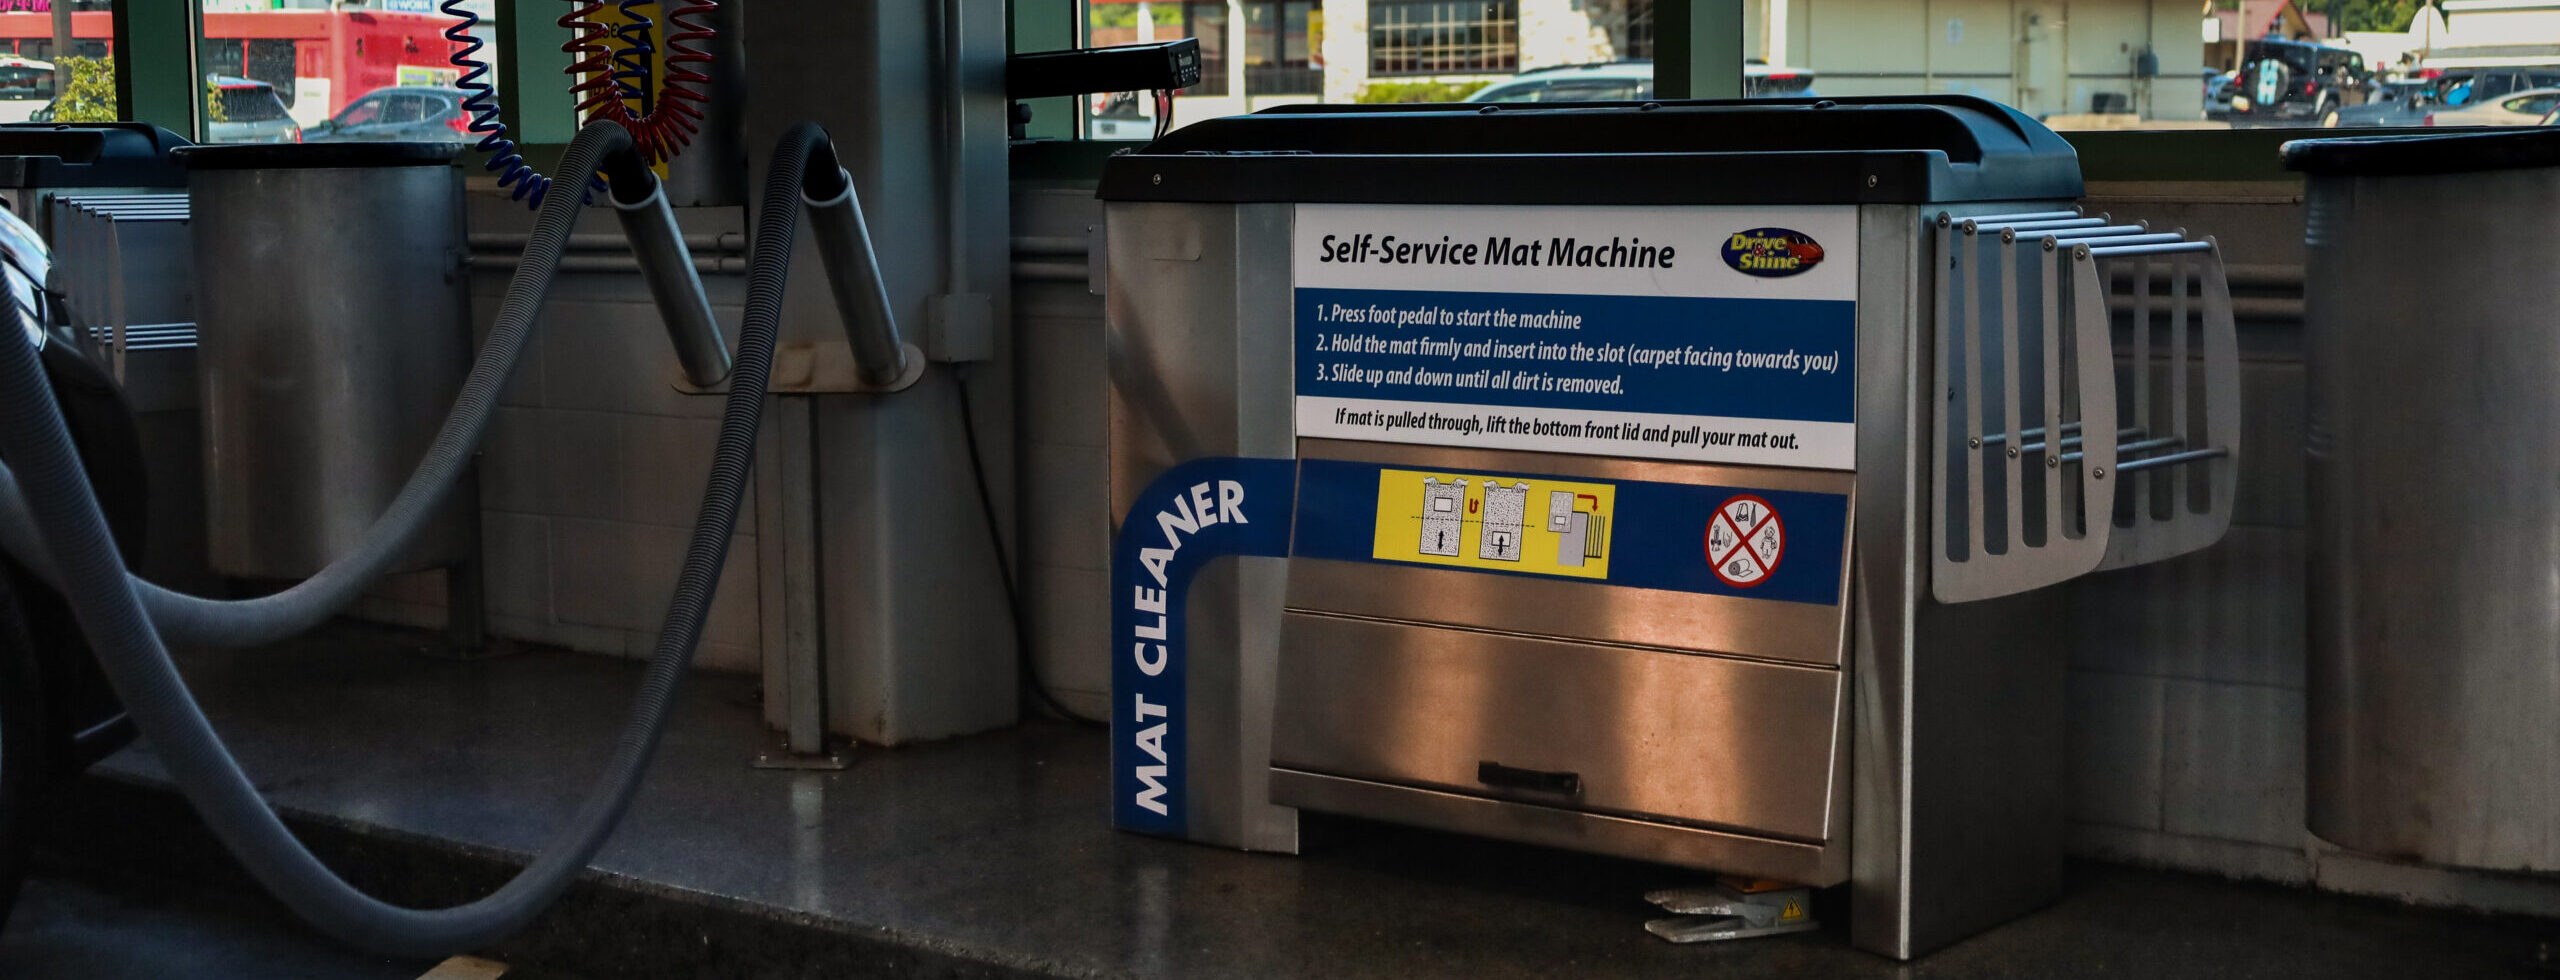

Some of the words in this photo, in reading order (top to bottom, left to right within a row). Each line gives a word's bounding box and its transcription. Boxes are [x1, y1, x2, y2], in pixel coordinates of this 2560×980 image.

[1320, 233, 1478, 266] Self-Service
[1483, 236, 1543, 267] Mat
[1547, 236, 1676, 269] Machine
[1731, 231, 1788, 250] Drive
[1739, 250, 1800, 270] Shine
[1317, 303, 1329, 323] 1.
[1331, 303, 1365, 324] Press
[1368, 304, 1398, 325] foot
[1397, 305, 1438, 329] pedal
[1439, 308, 1454, 326] to
[1455, 309, 1492, 327] start
[1493, 307, 1517, 328] the
[1519, 309, 1582, 330] machine
[1315, 333, 1329, 352] 2.
[1331, 333, 1364, 353] Hold
[1364, 334, 1388, 354] the
[1389, 340, 1417, 357] mat
[1420, 337, 1462, 362] firmly
[1463, 338, 1492, 358] and
[1493, 339, 1536, 360] insert
[1537, 340, 1568, 361] into
[1570, 341, 1595, 362] the
[1596, 342, 1626, 363] slot
[1627, 343, 1682, 370] (carpet
[1683, 345, 1733, 372] facing
[1735, 348, 1801, 370] towards
[1802, 350, 1839, 376] you)
[1316, 363, 1329, 381] 3.
[1331, 363, 1364, 383] Slide
[1365, 369, 1384, 389] up
[1385, 366, 1413, 385] and
[1414, 366, 1453, 387] down
[1455, 369, 1490, 389] until
[1491, 370, 1511, 390] all
[1512, 370, 1540, 391] dirt
[1541, 371, 1554, 392] is
[1555, 374, 1624, 395] removed.
[1335, 407, 1347, 425] If
[1346, 411, 1373, 426] mat
[1374, 409, 1385, 427] is
[1385, 410, 1427, 432] pulled
[1428, 412, 1484, 436] through,
[1486, 415, 1507, 434] lift
[1508, 416, 1531, 435] the
[1532, 417, 1582, 438] bottom
[1584, 420, 1620, 440] front
[1621, 422, 1641, 441] lid
[1642, 424, 1671, 443] and
[1670, 425, 1701, 448] pull
[1701, 431, 1736, 450] your
[1737, 431, 1769, 448] mat
[1769, 433, 1799, 450] out.
[1134, 479, 1249, 677] CLEANER
[1136, 693, 1168, 816] MAT
